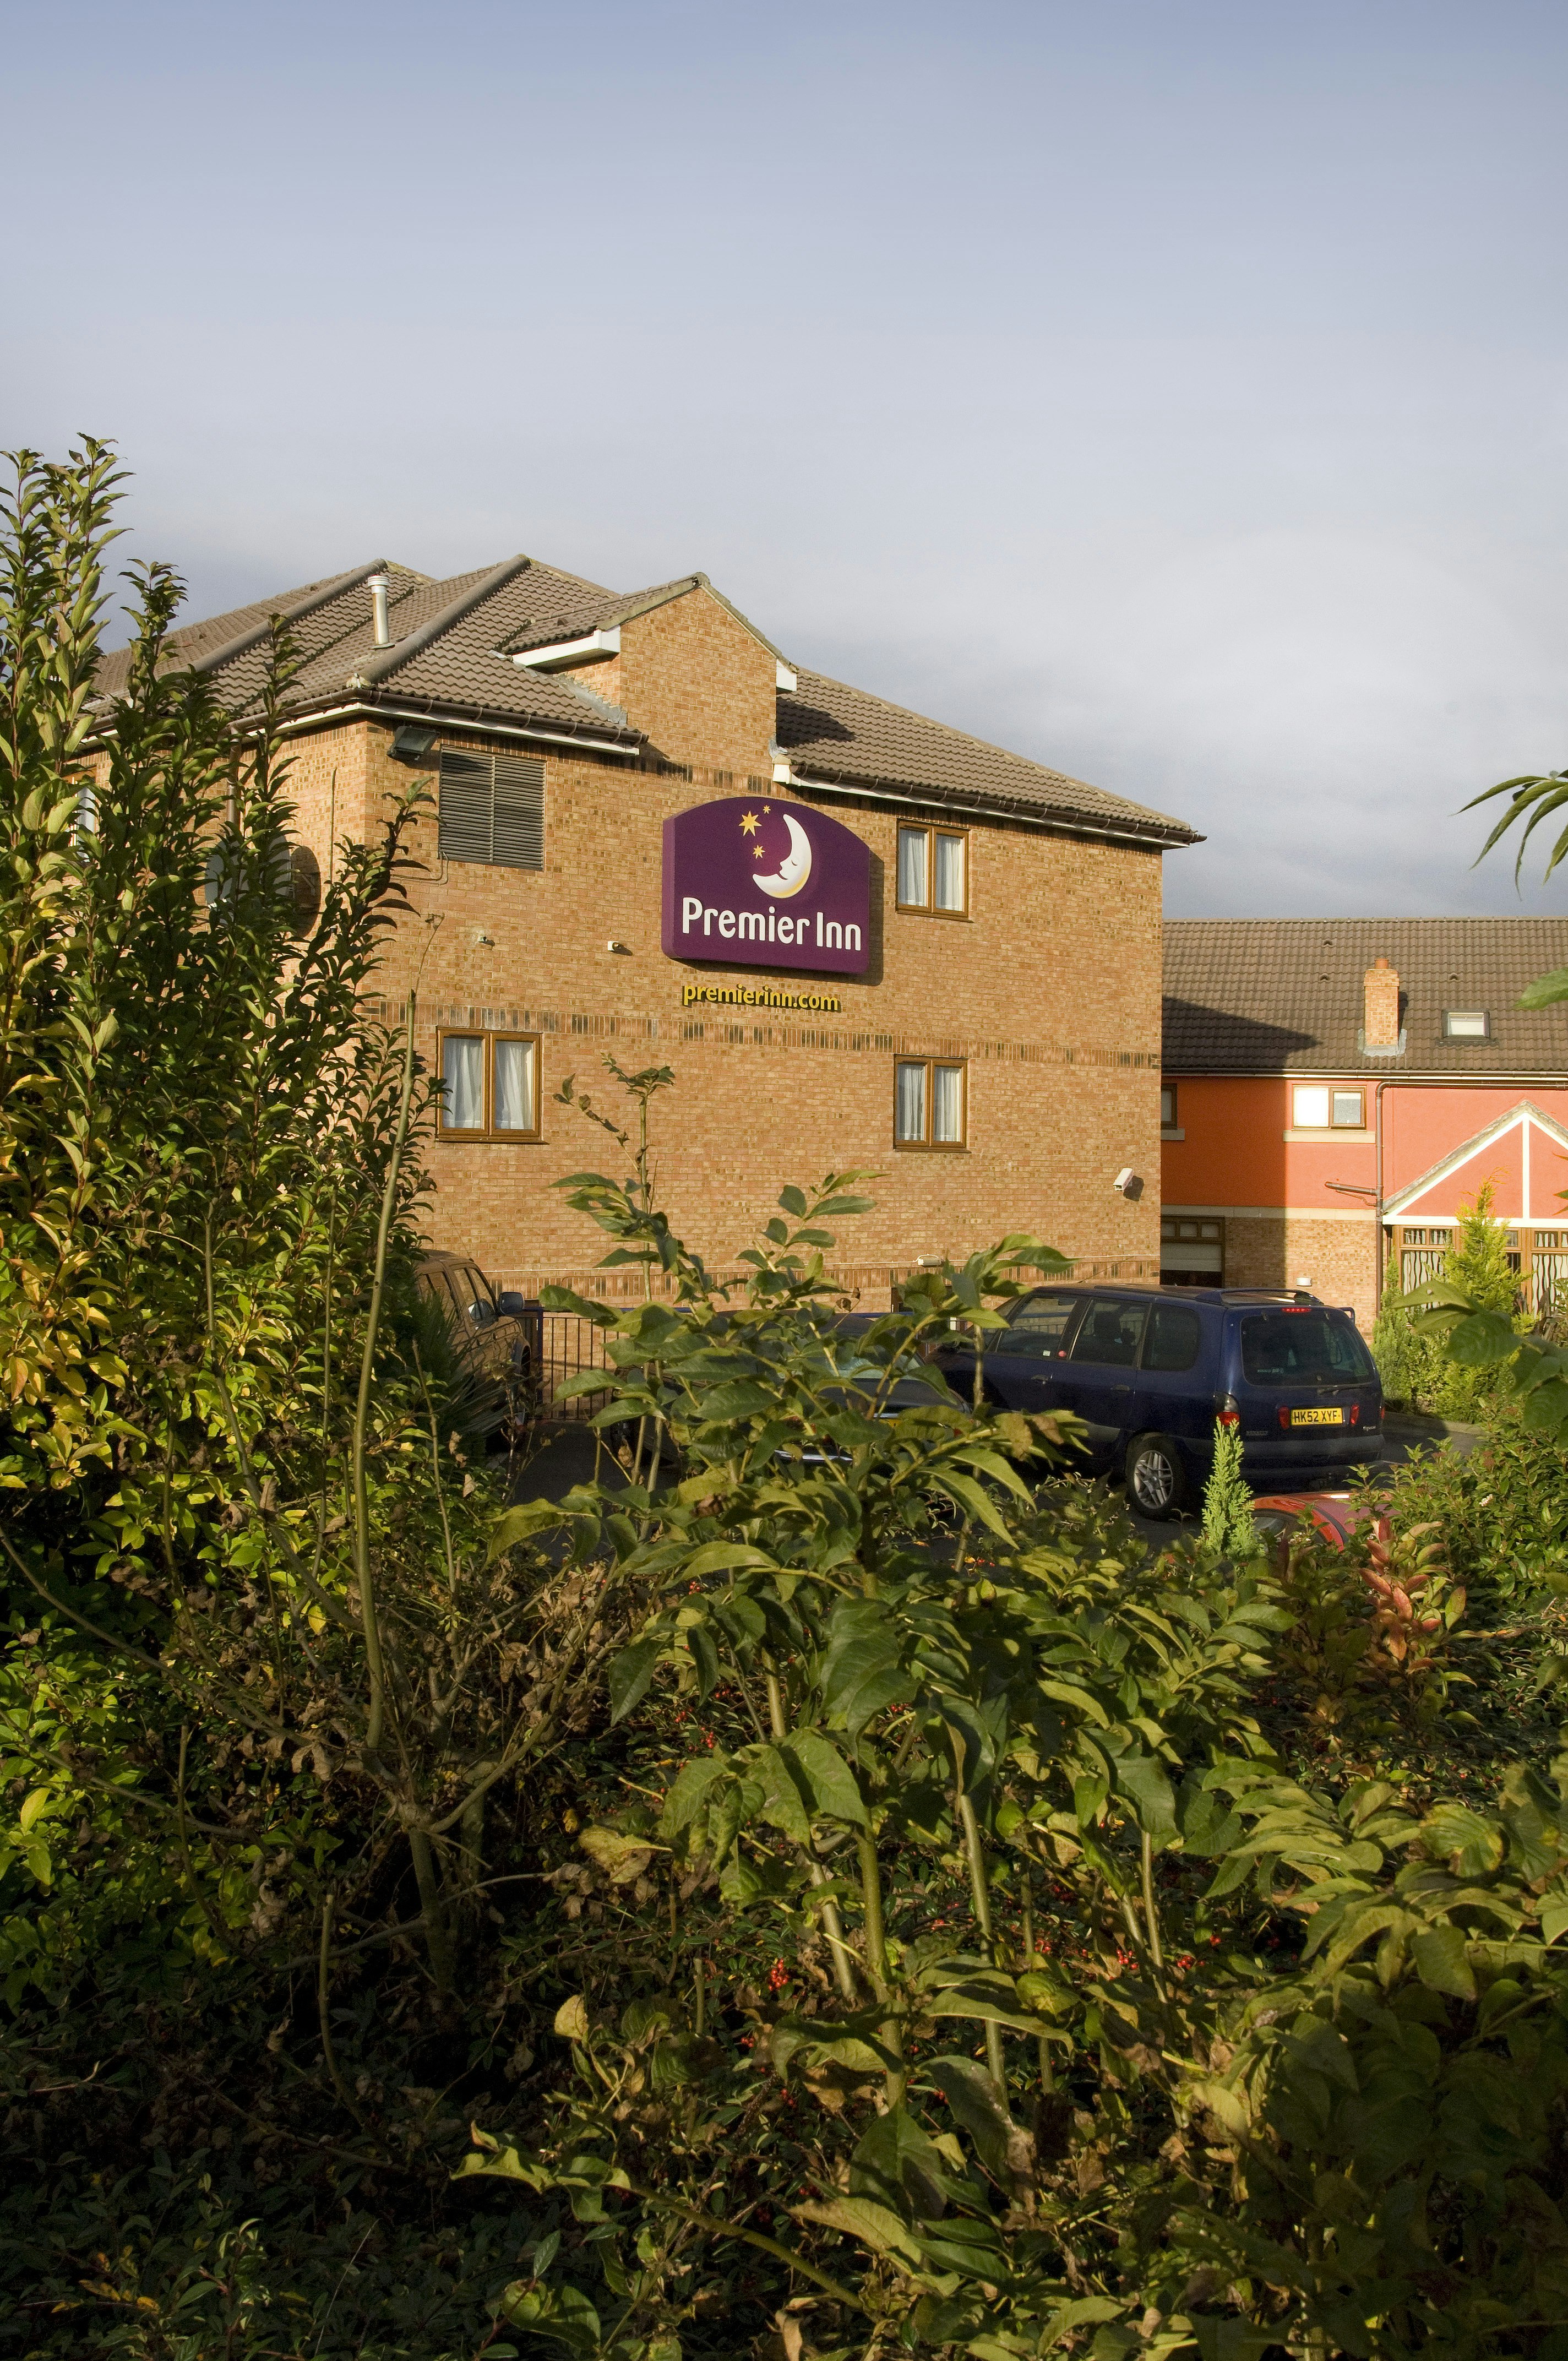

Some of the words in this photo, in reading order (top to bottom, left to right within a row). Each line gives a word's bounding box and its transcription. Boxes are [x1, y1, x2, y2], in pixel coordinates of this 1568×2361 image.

[682, 897, 810, 945] Premier
[816, 912, 861, 951] Inn
[683, 984, 839, 1010] premierinn.com
[1294, 1411, 1319, 1423] HK52
[1321, 1410, 1338, 1422] XYF
